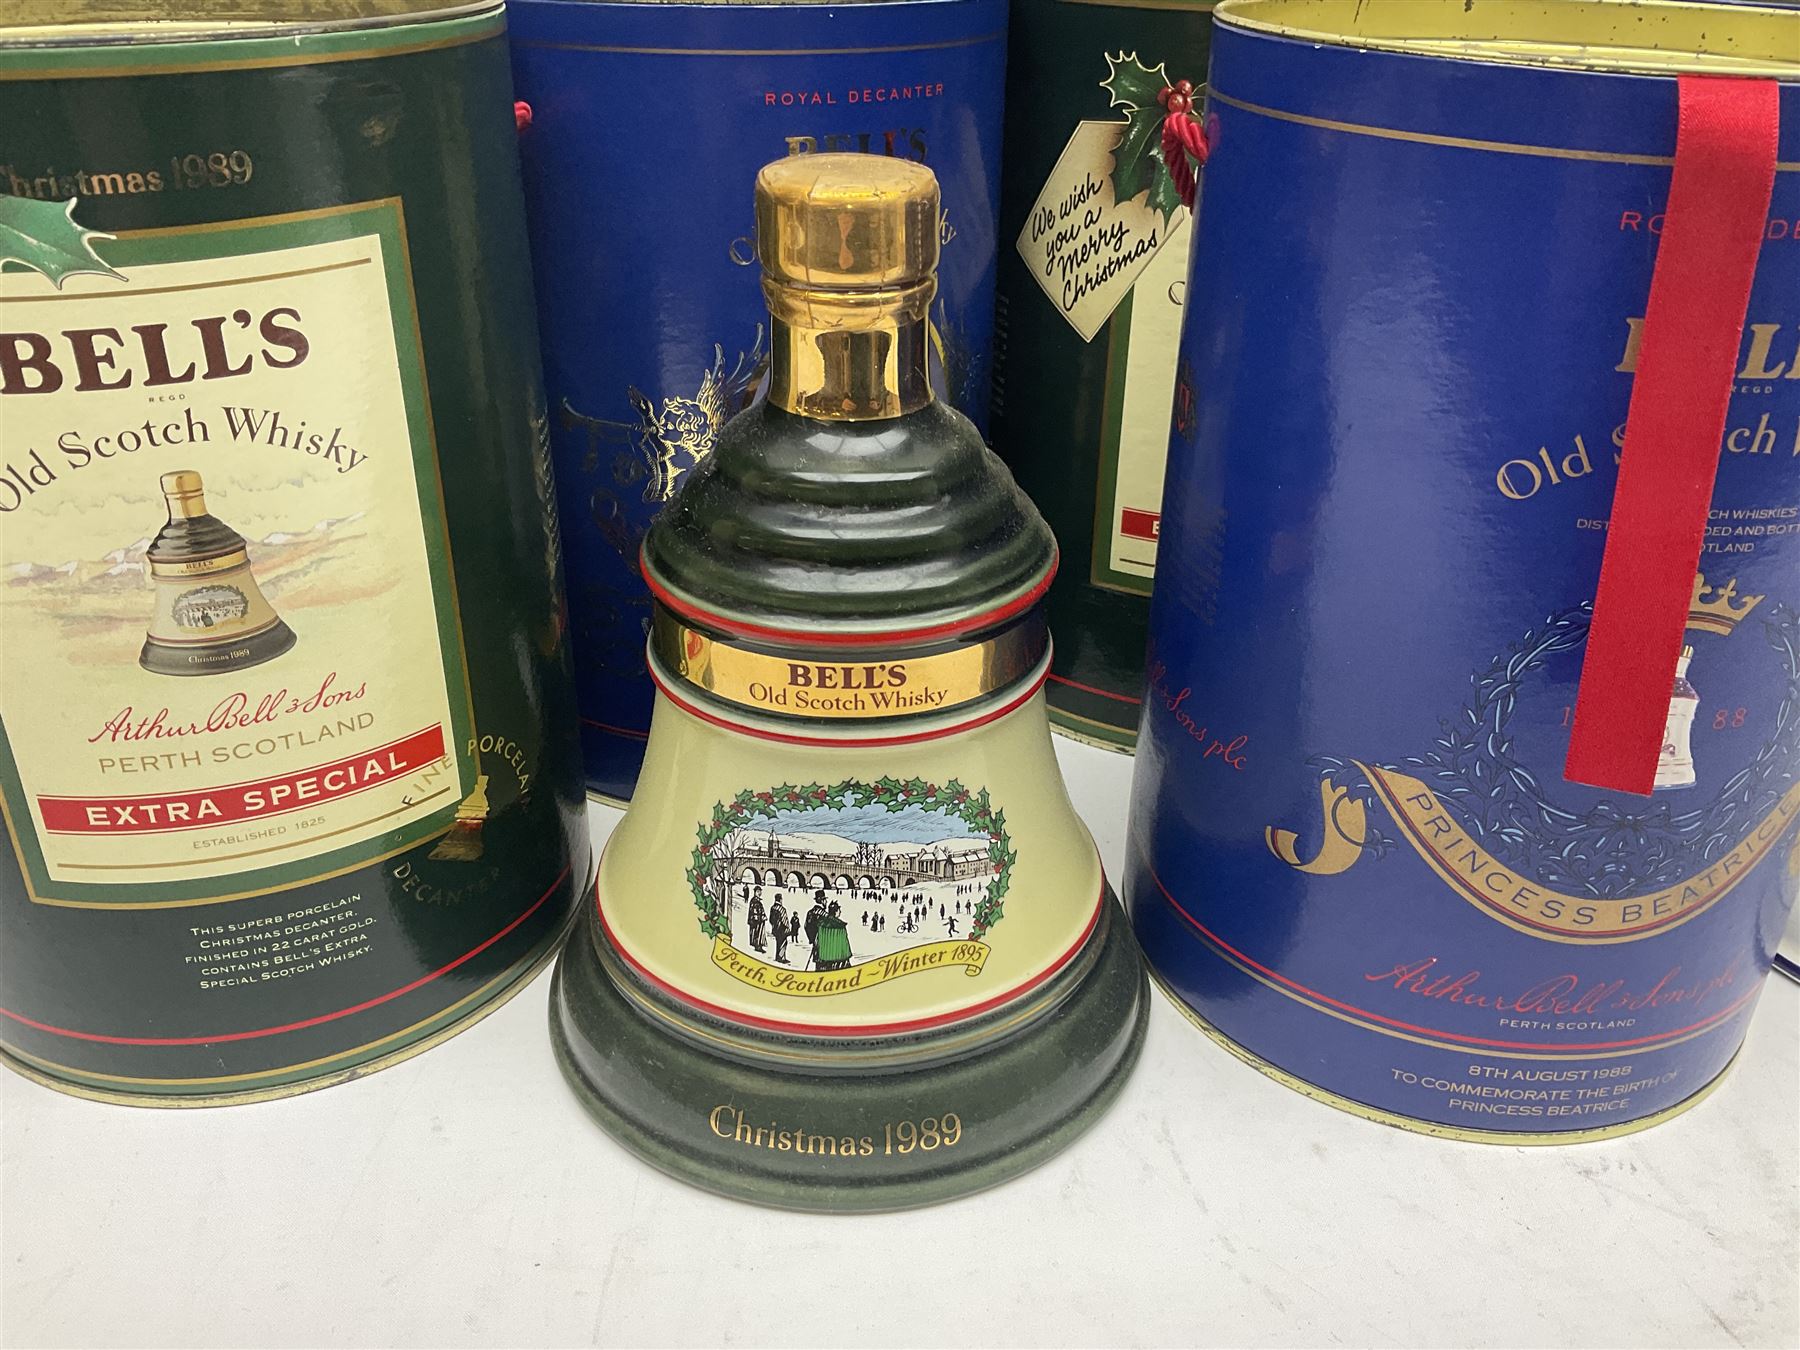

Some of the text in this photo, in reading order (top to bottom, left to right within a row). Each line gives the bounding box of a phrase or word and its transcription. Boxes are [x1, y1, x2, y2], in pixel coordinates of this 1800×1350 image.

[765, 83, 944, 105] ROYAL DECANTER
[170, 150, 254, 193] 1989
[1032, 172, 1104, 243] We wish
[1046, 206, 1102, 276] you a
[1062, 228, 1158, 312] Christmas
[0, 307, 310, 395] BELL'S
[149, 393, 187, 403] REGD
[57, 407, 210, 470] Scotch
[221, 406, 369, 474] Whisky
[1496, 434, 1593, 500] Old
[1733, 507, 1798, 520] WHISKIES
[1734, 526, 1764, 536] AND
[188, 648, 250, 664] Christmas 1989
[787, 663, 908, 690] BELL'S
[88, 706, 207, 744] Arthur
[203, 688, 289, 732] Bell
[298, 671, 368, 713] Sons
[749, 682, 949, 711] Old Scotch Whisky
[98, 712, 376, 774] PERTH SCOTLAND
[85, 750, 408, 827] EXTRA SPECIAL
[401, 753, 453, 807] FINE
[192, 815, 326, 850] ESTABLISHED 1825
[1405, 792, 1795, 926] PRINCESS BEATRICE
[190, 893, 362, 937] THIS SUPERB PORCELAIN
[184, 949, 250, 965] FINISHED
[253, 946, 268, 956] IN
[271, 940, 291, 952] 22
[293, 929, 336, 947] CARAT
[199, 930, 281, 949] CHRISTMAS
[201, 933, 368, 976] CONTAINS BELL'S EXTRA
[200, 974, 258, 990] SPECIAL
[261, 962, 315, 982] SCOTCH
[715, 947, 767, 986] Perth,
[769, 971, 862, 994] Scotland
[951, 943, 984, 963] 1895
[1364, 956, 1508, 1013] Arthur
[1506, 975, 1625, 1015] Bell
[1500, 1018, 1636, 1031] PERTH SCOTLAND
[1392, 1068, 1418, 1084] TO
[1421, 1077, 1573, 1101] COMMEMORATE
[1576, 1087, 1611, 1099] THE
[1613, 1076, 1661, 1095] BIRTH
[1469, 1065, 1633, 1082] 8TH AUGUST 1988
[1449, 1098, 1630, 1116] PRINCESS BEATRICE
[708, 1104, 962, 1157] Christmas 1989
